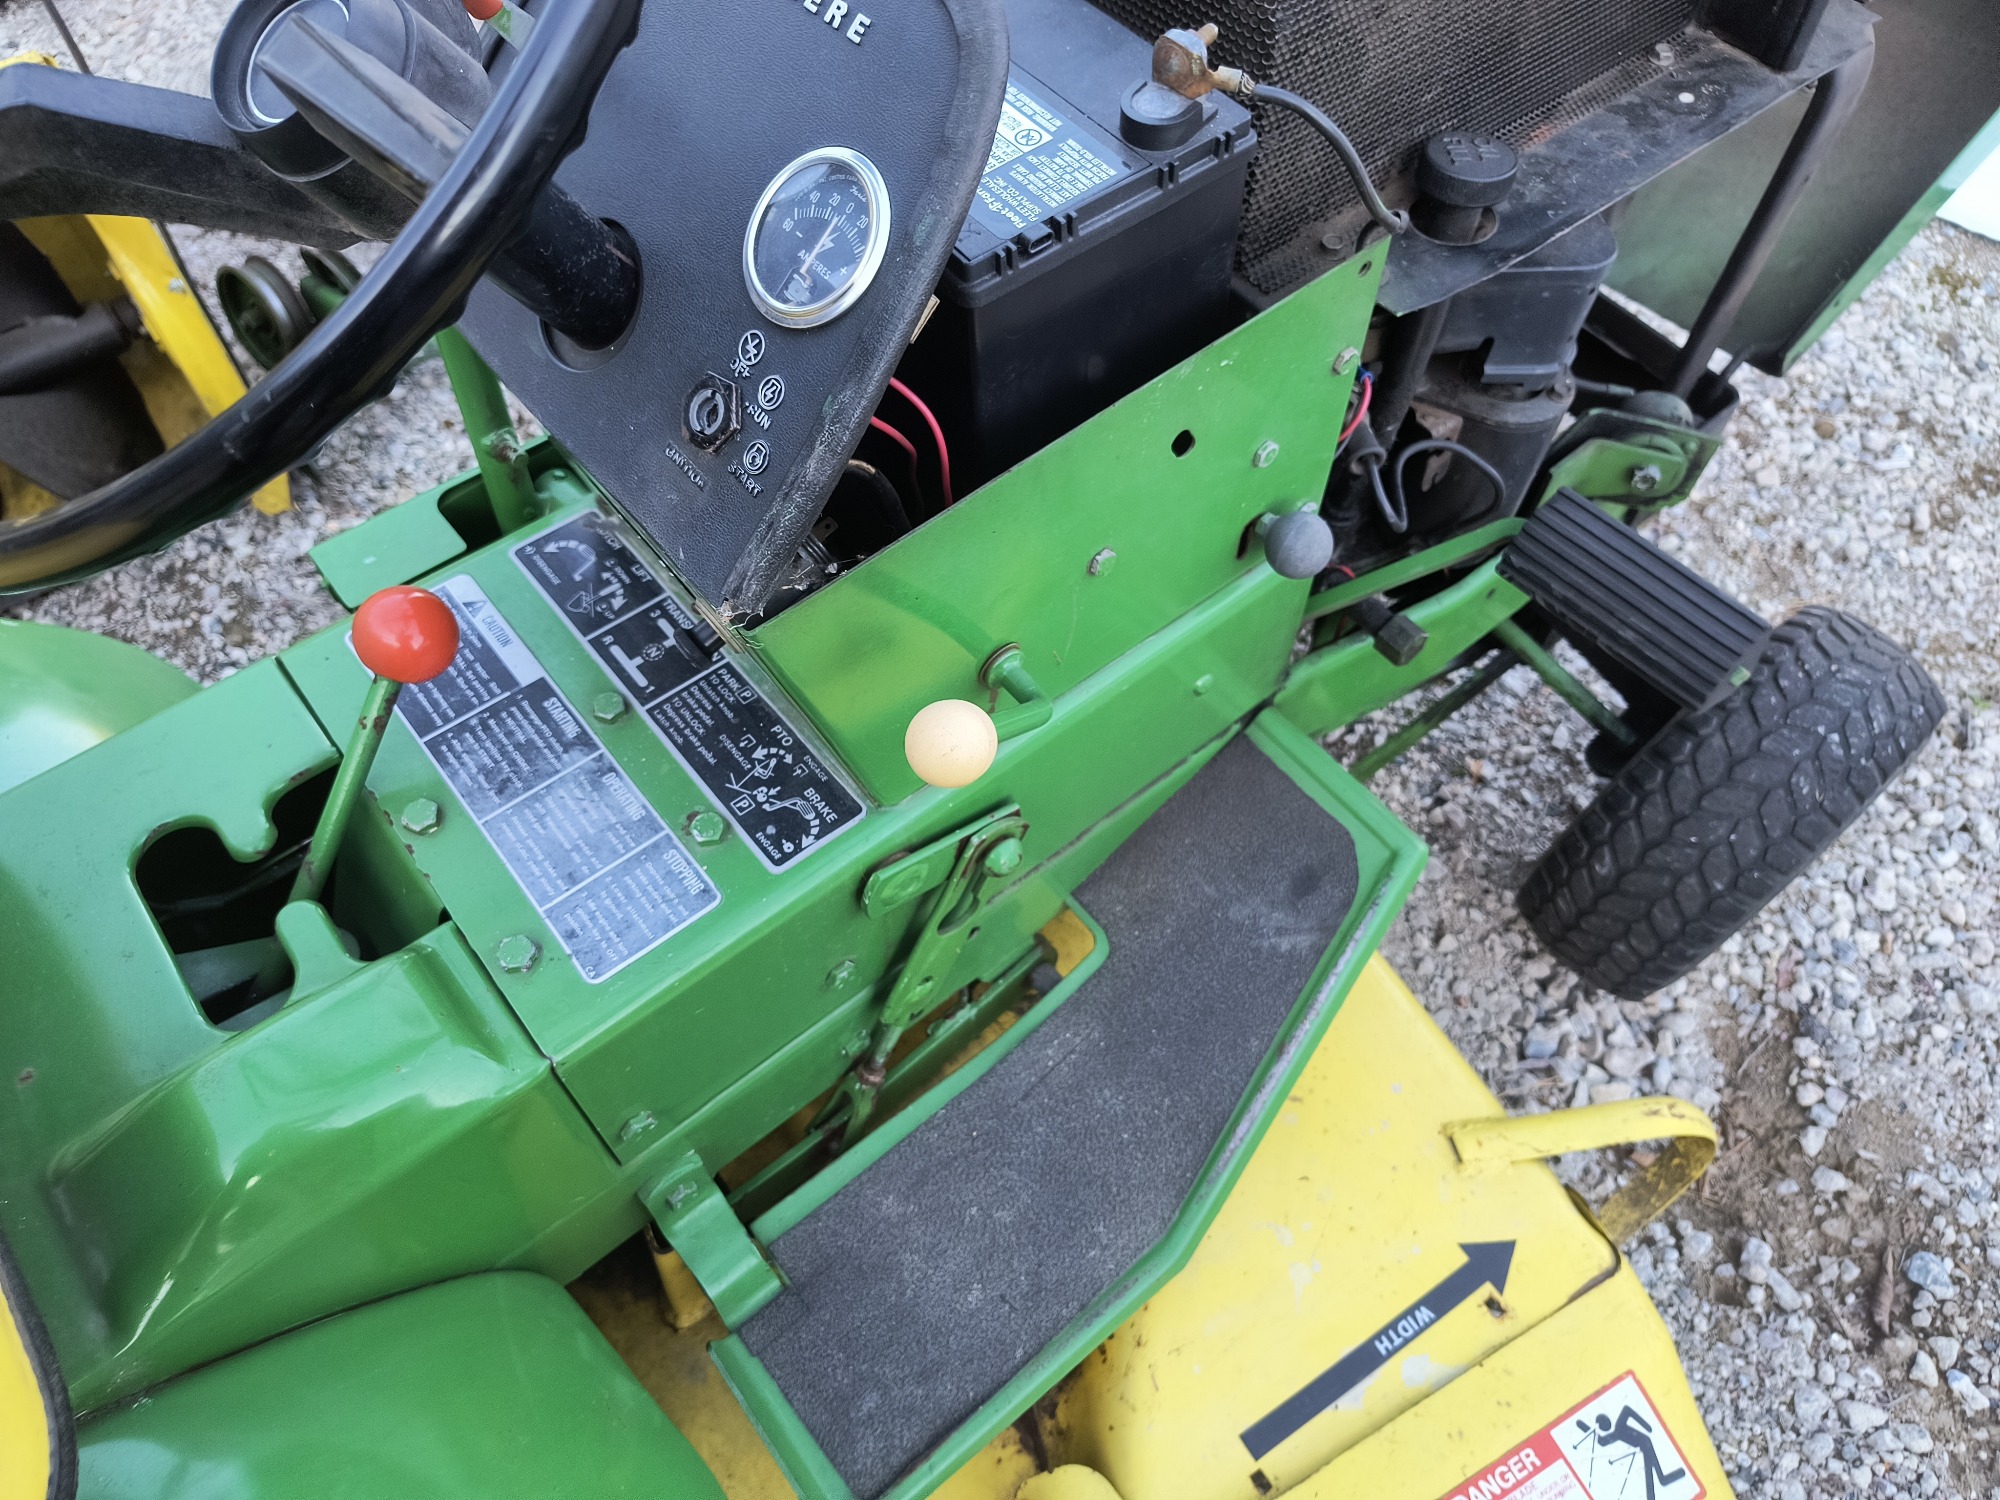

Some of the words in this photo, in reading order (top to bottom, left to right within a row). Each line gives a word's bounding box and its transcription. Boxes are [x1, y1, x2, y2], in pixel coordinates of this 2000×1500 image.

[809, 190, 821, 203] 40
[829, 192, 841, 206] 20
[979, 177, 1019, 206] WHOLESALE
[1016, 195, 1042, 214] SUPPLY
[845, 202, 855, 214] 0
[999, 207, 1027, 228] Fleet
[1015, 205, 1038, 221] FLEET
[782, 218, 794, 232] 60
[857, 215, 869, 229] 20
[727, 461, 764, 497] START
[630, 563, 651, 583] LIFT
[604, 609, 614, 621] UP
[648, 607, 661, 619] 3
[482, 613, 513, 648] CAUTION
[601, 633, 615, 646] R
[646, 645, 660, 659] N
[470, 679, 490, 700] parking
[487, 680, 501, 695] Shift
[644, 683, 655, 694] 1
[708, 673, 720, 685] TO
[718, 684, 737, 705] LOCK:
[718, 668, 740, 690] PARK
[682, 691, 698, 708] brake
[695, 707, 714, 726] pedal.
[690, 685, 712, 710] Depress
[699, 680, 720, 702] Unlatch
[719, 702, 735, 719] knob.
[541, 695, 582, 739] STARTING
[654, 709, 670, 726] Latch
[668, 727, 685, 744] knob.
[670, 696, 682, 708] TO
[680, 707, 706, 737] UNLOCK:
[538, 724, 553, 738] PTO
[663, 702, 684, 728] Depress
[683, 727, 701, 746] brake
[698, 745, 717, 765] pedal.
[771, 724, 793, 747] PTO
[474, 726, 488, 740] Turn
[483, 739, 503, 762] ignition
[498, 760, 512, 774] key
[507, 771, 524, 790] clock-
[476, 749, 495, 770] START.
[719, 734, 751, 770] DISENGAGE
[803, 755, 828, 782] ENGAGE
[602, 771, 646, 821] OPERATING
[804, 787, 837, 823] BRAKE
[575, 838, 592, 857] pedal
[589, 855, 603, 869] and
[755, 831, 781, 859] ENGAGE
[525, 838, 545, 860] parking
[543, 860, 559, 877] brake
[555, 877, 569, 891] and
[662, 847, 704, 895] STOPPING
[623, 875, 643, 897] parking
[634, 868, 649, 885] brake
[645, 884, 663, 903] pedals
[659, 901, 672, 915] and
[667, 912, 679, 924] set
[644, 861, 665, 885] Depress
[662, 885, 679, 904] clutch
[677, 904, 689, 916] and
[610, 884, 627, 903] Lower
[625, 904, 655, 939] attachment
[574, 905, 594, 928] ignition
[589, 928, 602, 941] key
[599, 939, 609, 949] to
[605, 948, 618, 961] OFF
[592, 911, 611, 932] engine
[607, 929, 622, 943] and
[617, 942, 630, 955] turn
[584, 966, 596, 979] CA
[1374, 1305, 1436, 1357] WIDTH
